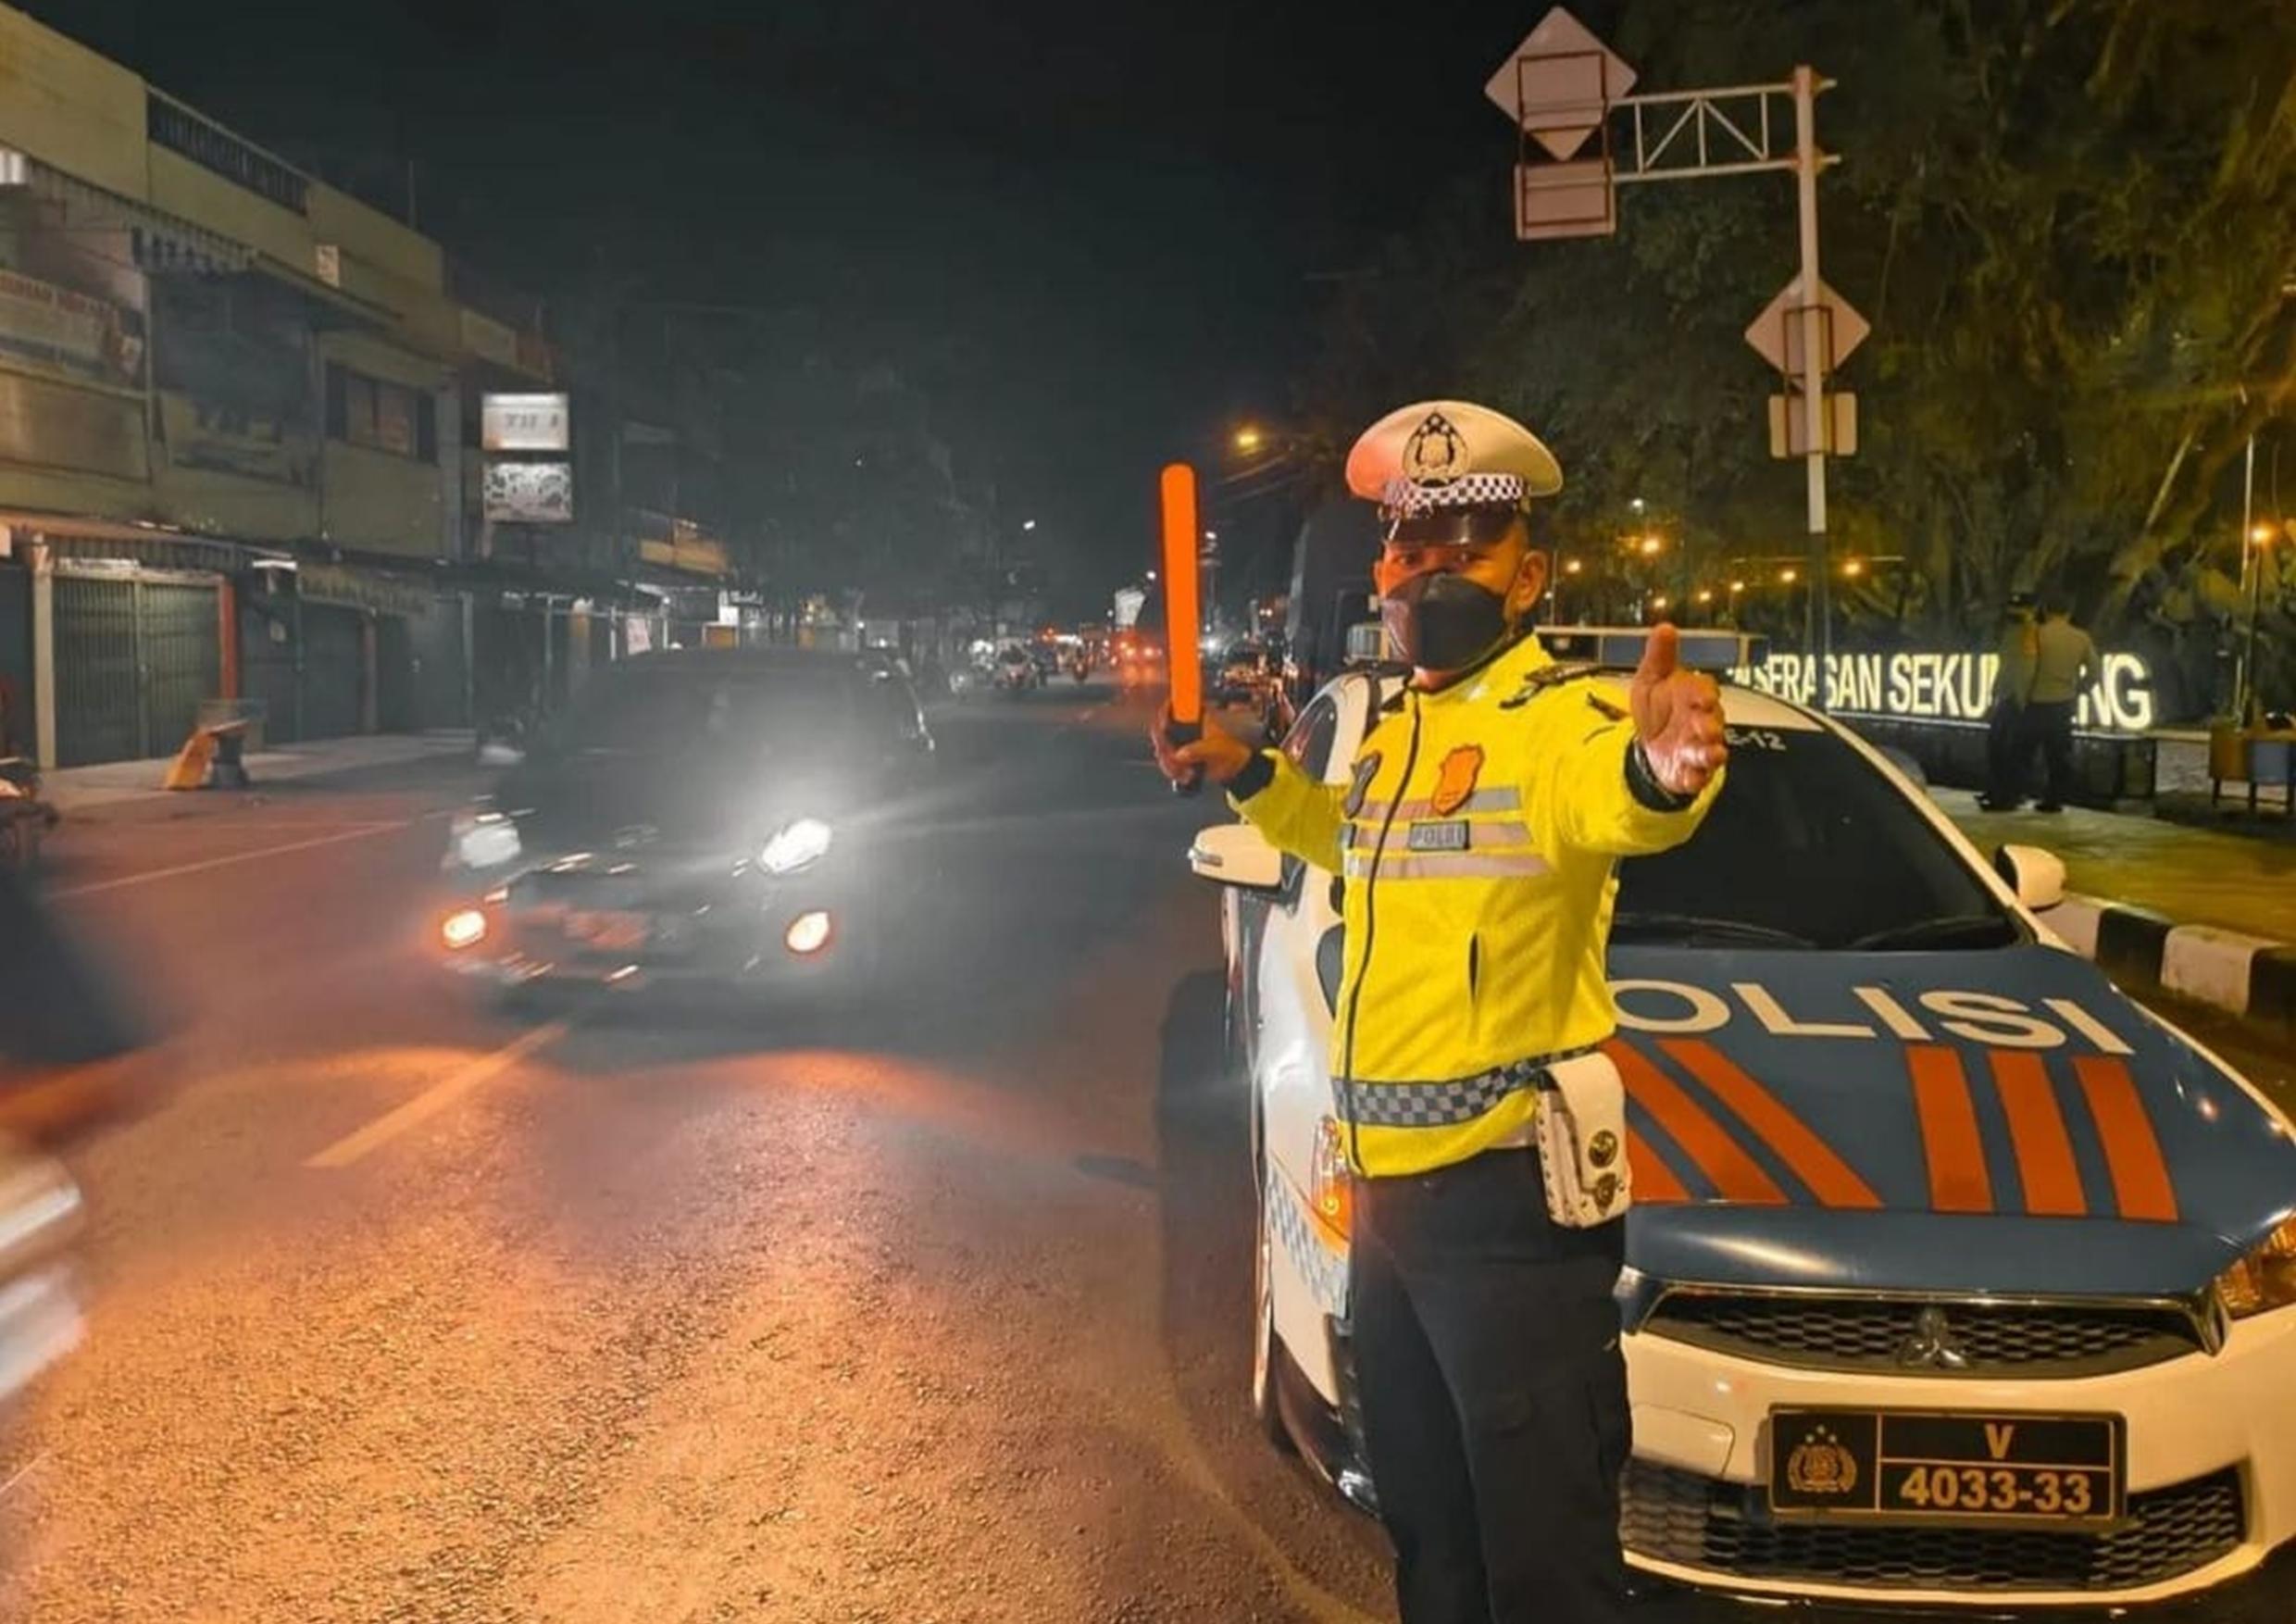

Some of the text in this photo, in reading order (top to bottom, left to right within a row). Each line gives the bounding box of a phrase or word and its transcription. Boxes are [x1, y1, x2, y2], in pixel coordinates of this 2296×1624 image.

[1888, 653, 2152, 730] SEKUNG
[1608, 979, 2136, 1054] OLISI
[1984, 1423, 2015, 1460] V
[1900, 1466, 2091, 1515] 4033-33
